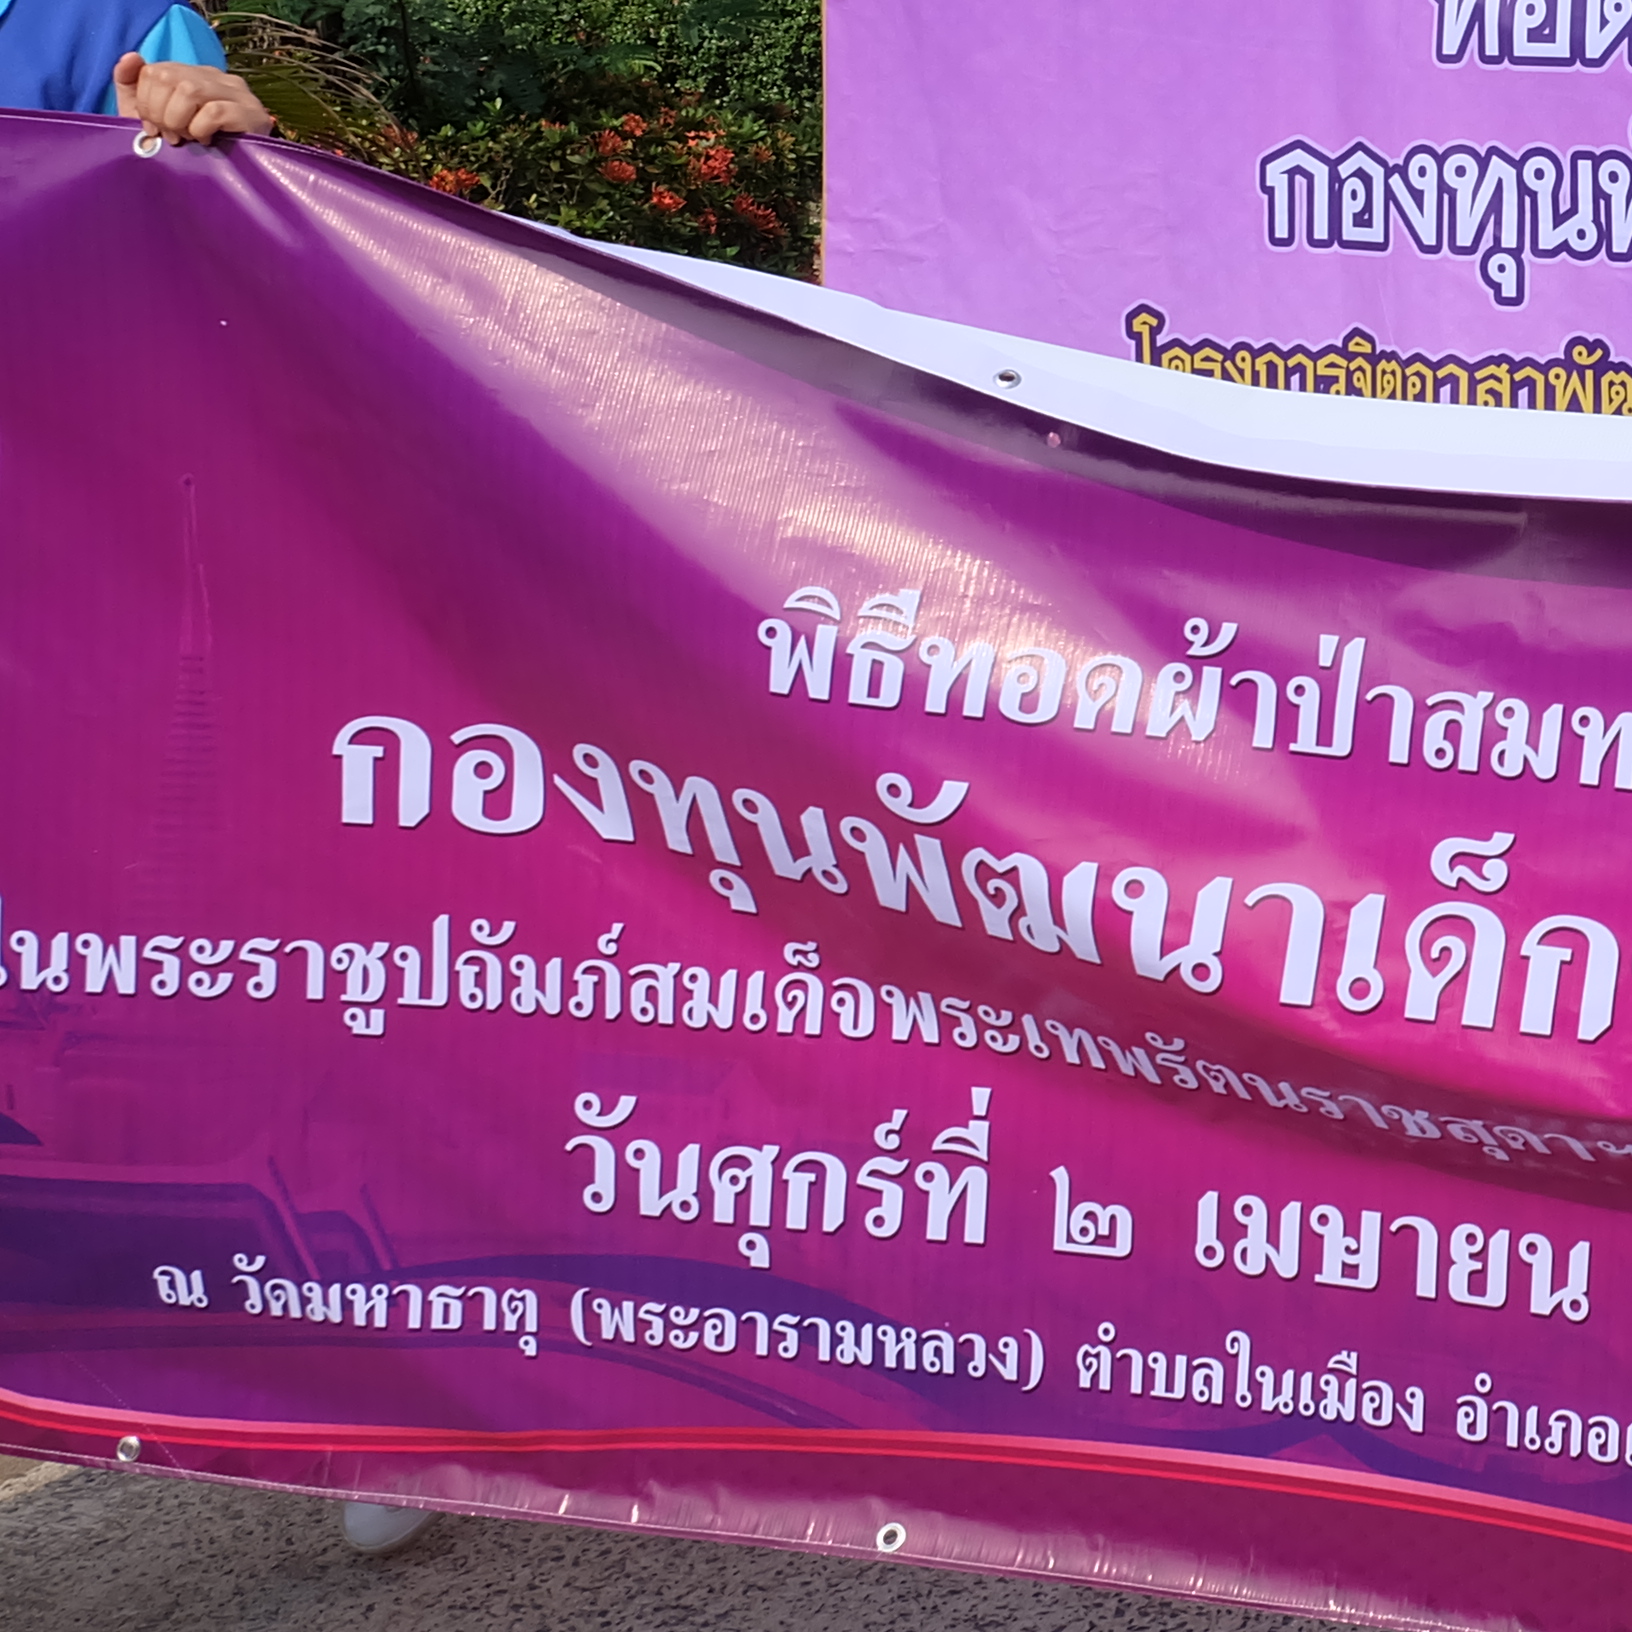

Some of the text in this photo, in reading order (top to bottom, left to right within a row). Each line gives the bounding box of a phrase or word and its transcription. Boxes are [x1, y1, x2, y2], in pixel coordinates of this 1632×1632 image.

[564, 1086, 992, 1269] วันศุกร์ที่
[1050, 1165, 1132, 1257] ๒
[1195, 1190, 1591, 1321] เมษายน
[153, 1258, 208, 1308] ณ
[232, 1253, 538, 1357] วัดมหาธาตุ
[571, 1288, 1045, 1391] (พระอารามหลวง)
[1076, 1322, 1424, 1432] ตำบลในเมือง
